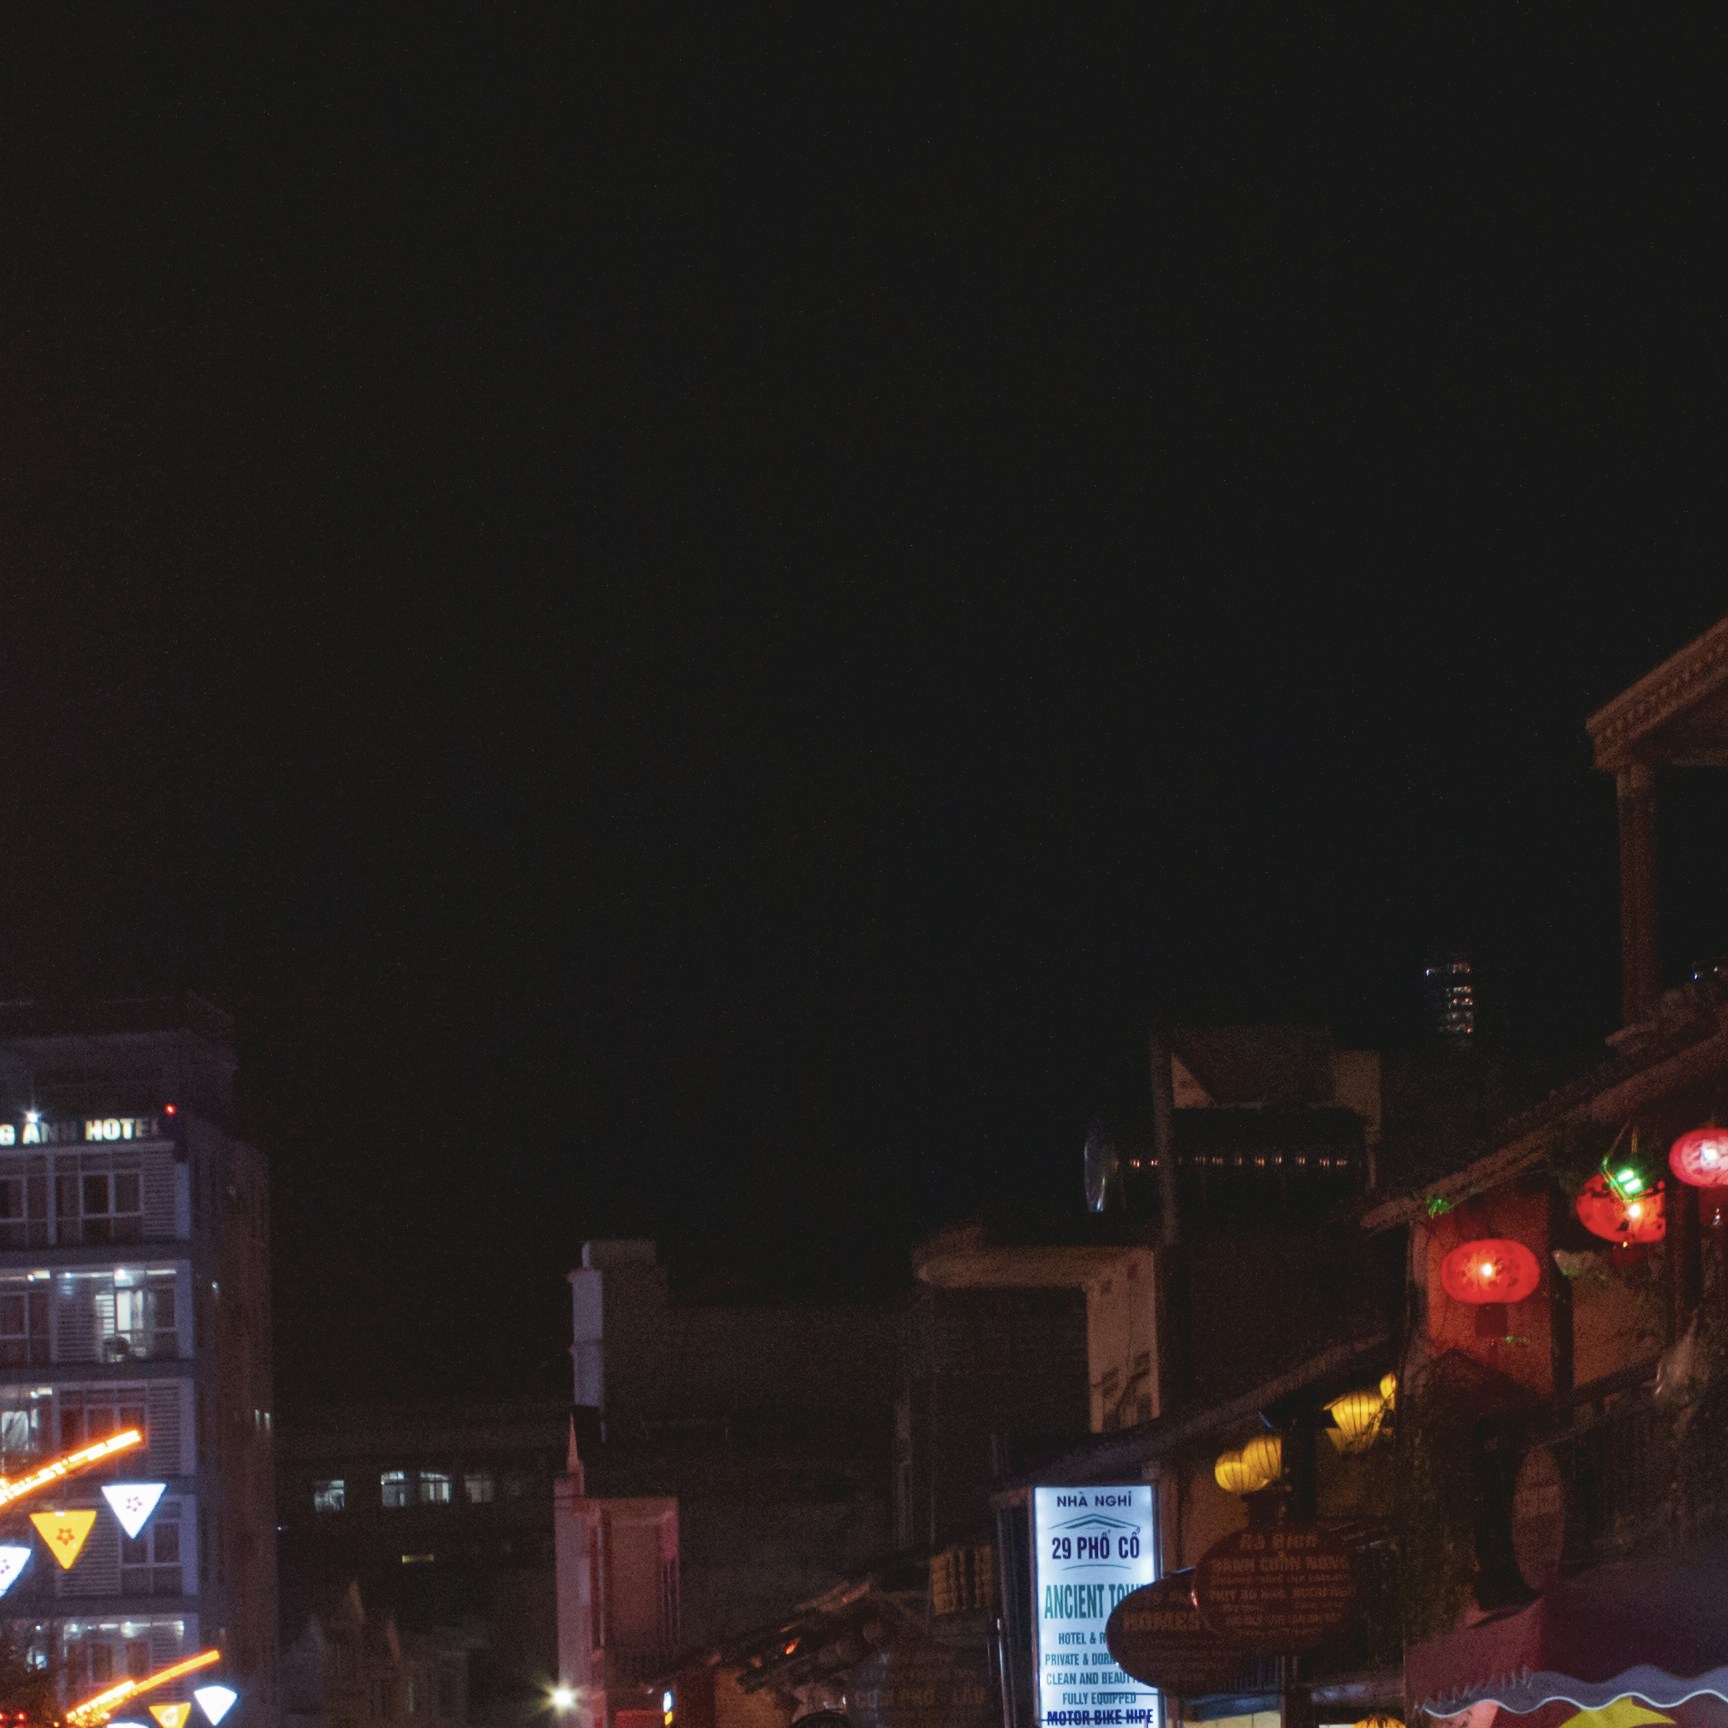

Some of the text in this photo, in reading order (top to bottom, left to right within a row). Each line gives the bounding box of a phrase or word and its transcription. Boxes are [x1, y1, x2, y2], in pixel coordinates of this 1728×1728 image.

[1056, 1490, 1132, 1508] NHÀ NGHỈ
[1051, 1526, 1141, 1560] 29 PHỐ CỔ
[1044, 1584, 1105, 1620] ANCIENT
[1058, 1632, 1087, 1645] HOTEL
[1044, 1653, 1080, 1666] PRIVATE
[1046, 1672, 1077, 1685] CLEAN
[1079, 1671, 1099, 1684] AND
[1062, 1691, 1137, 1705] FULLY EQUIPPED
[1047, 1710, 1091, 1726] MOTOR
[1094, 1709, 1123, 1725] BIKE
